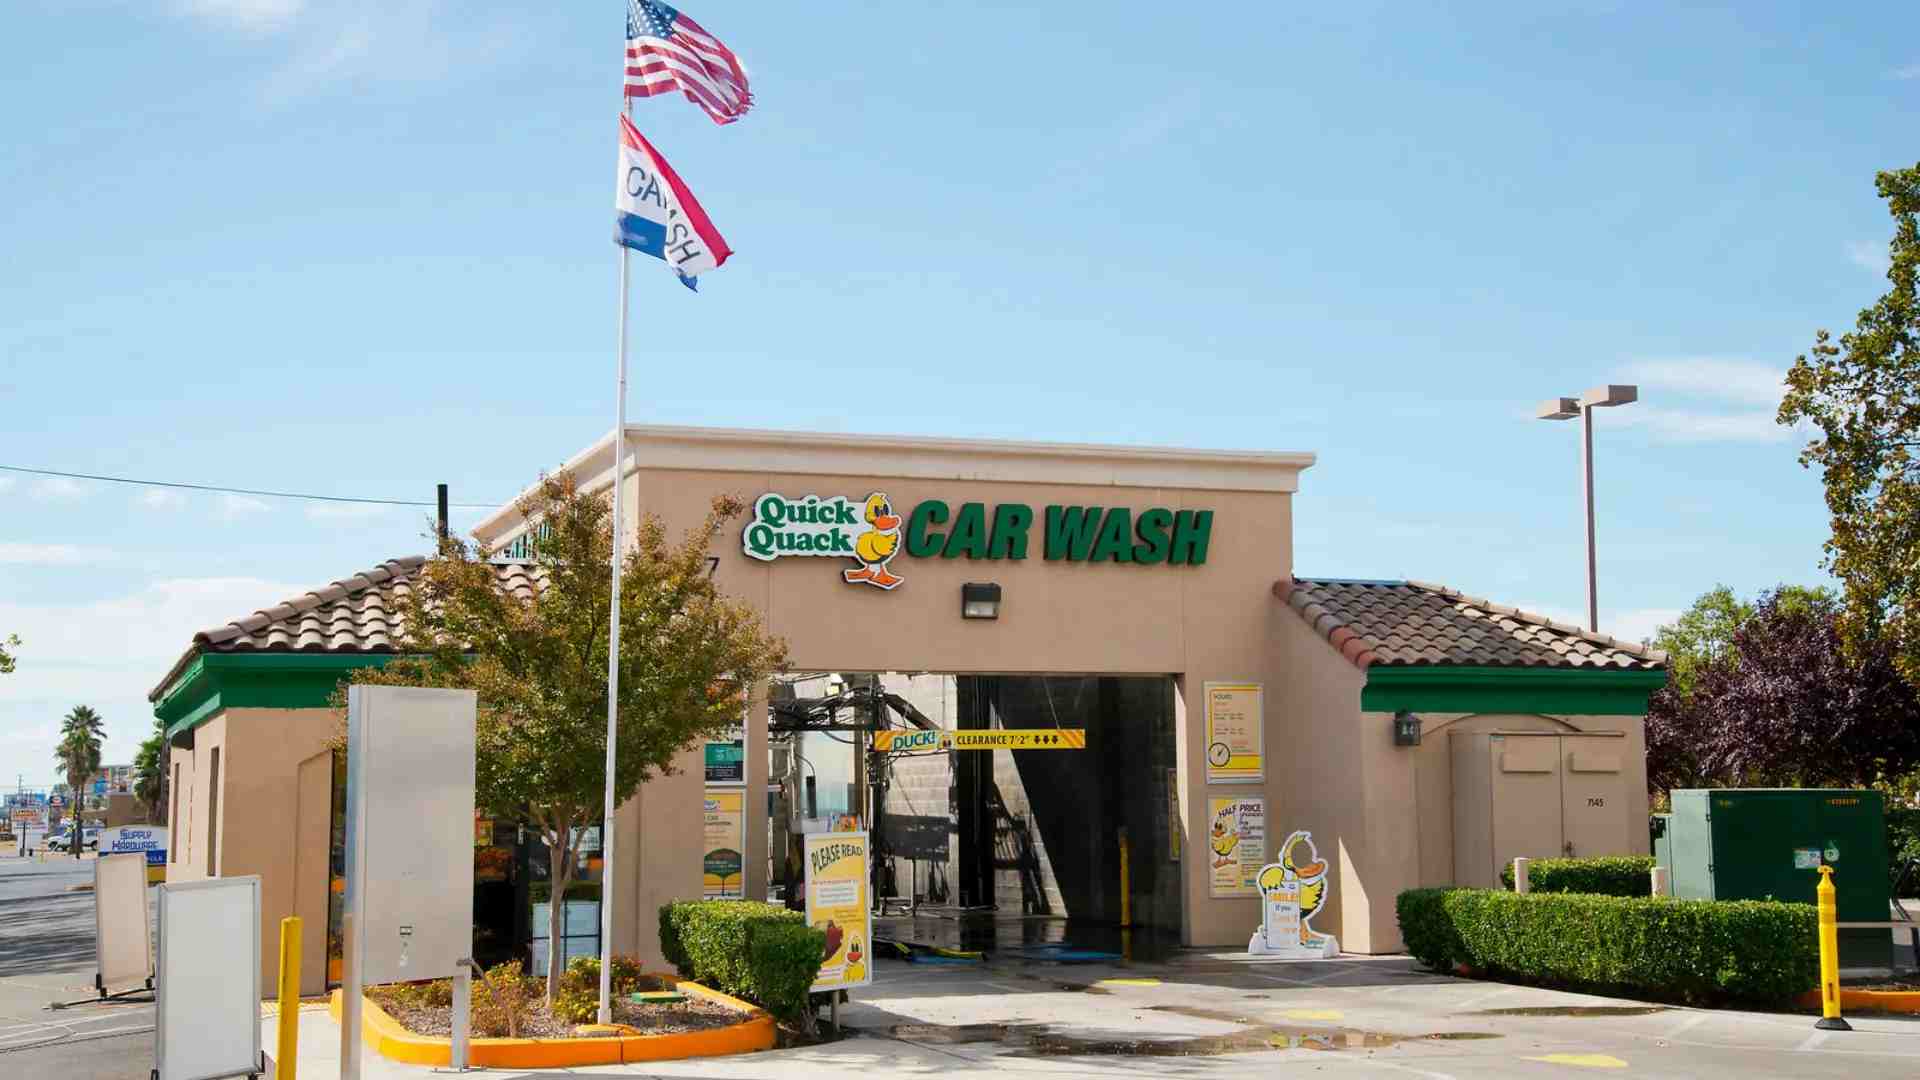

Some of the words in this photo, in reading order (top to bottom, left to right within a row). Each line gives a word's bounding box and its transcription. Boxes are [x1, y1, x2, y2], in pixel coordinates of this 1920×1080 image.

[626, 166, 667, 209] CA
[761, 497, 858, 528] Quick
[749, 525, 853, 555] Quack
[906, 499, 1033, 560] CAR
[1044, 504, 1214, 565] WASH
[893, 731, 936, 752] DUCK!
[956, 735, 1007, 745] CLEARANCE
[1586, 798, 1604, 807] 7545
[810, 844, 840, 876] PLEASE
